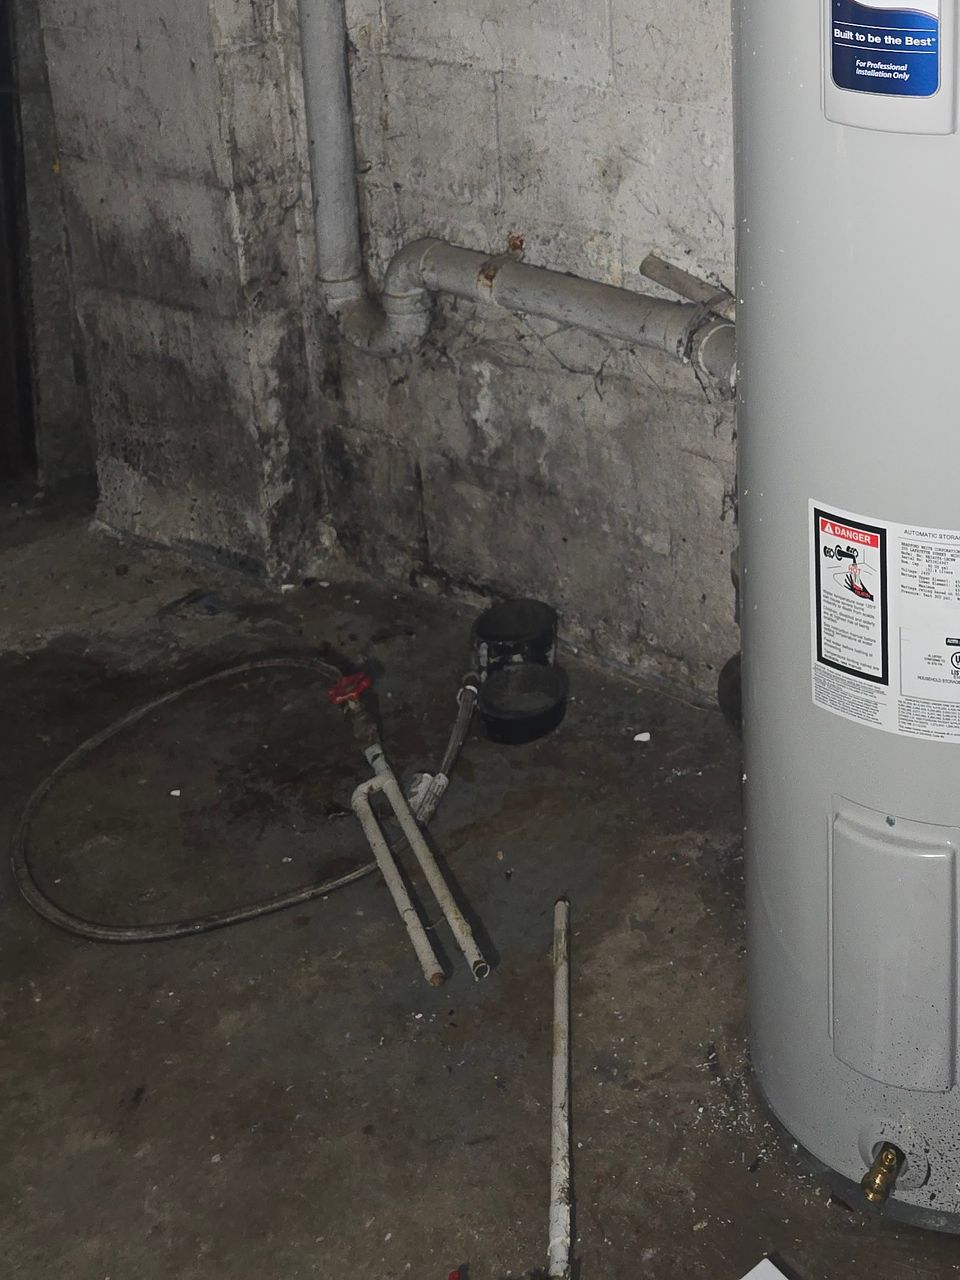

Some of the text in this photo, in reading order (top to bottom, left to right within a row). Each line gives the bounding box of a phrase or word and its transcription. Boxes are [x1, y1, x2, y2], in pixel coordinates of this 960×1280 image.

[834, 29, 932, 46] Built to be the Best
[856, 60, 908, 71] For Professional
[856, 68, 910, 81] Installation Only
[834, 526, 870, 544] DANGER
[904, 529, 938, 538] AUTOMATIC
